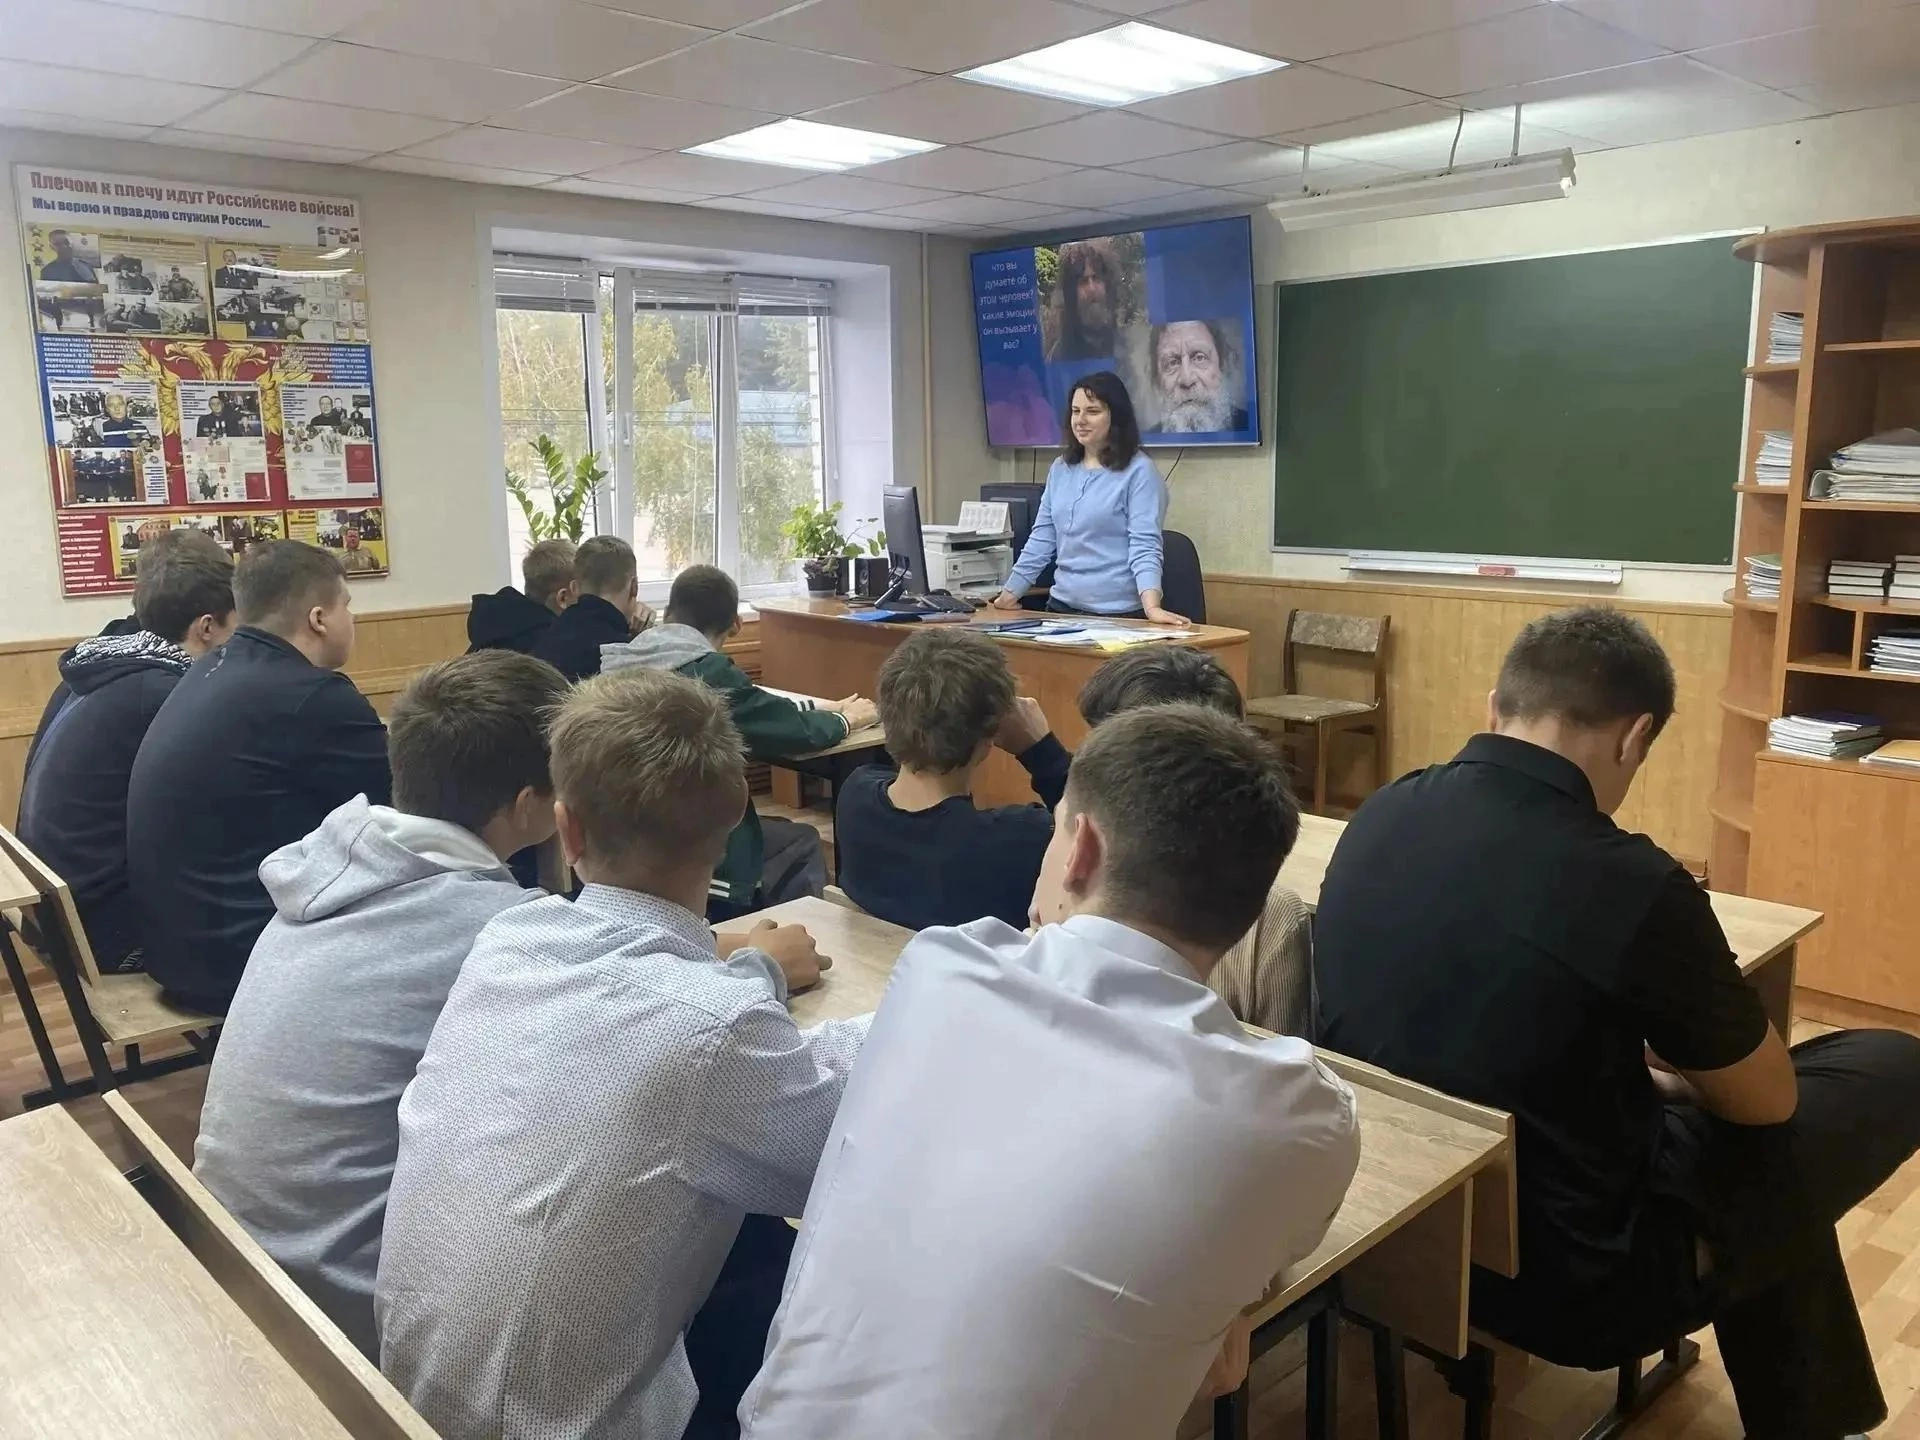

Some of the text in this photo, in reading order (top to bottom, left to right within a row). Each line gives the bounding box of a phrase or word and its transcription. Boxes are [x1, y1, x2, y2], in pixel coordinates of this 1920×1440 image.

[30, 171, 98, 195] Плечом
[115, 183, 163, 201] плечу
[166, 189, 204, 206] идут
[207, 190, 297, 213] Российские
[300, 200, 355, 218] войска!
[32, 196, 56, 211] Мы
[58, 200, 101, 215] верою
[113, 206, 170, 221] правдою
[172, 211, 220, 225] служим
